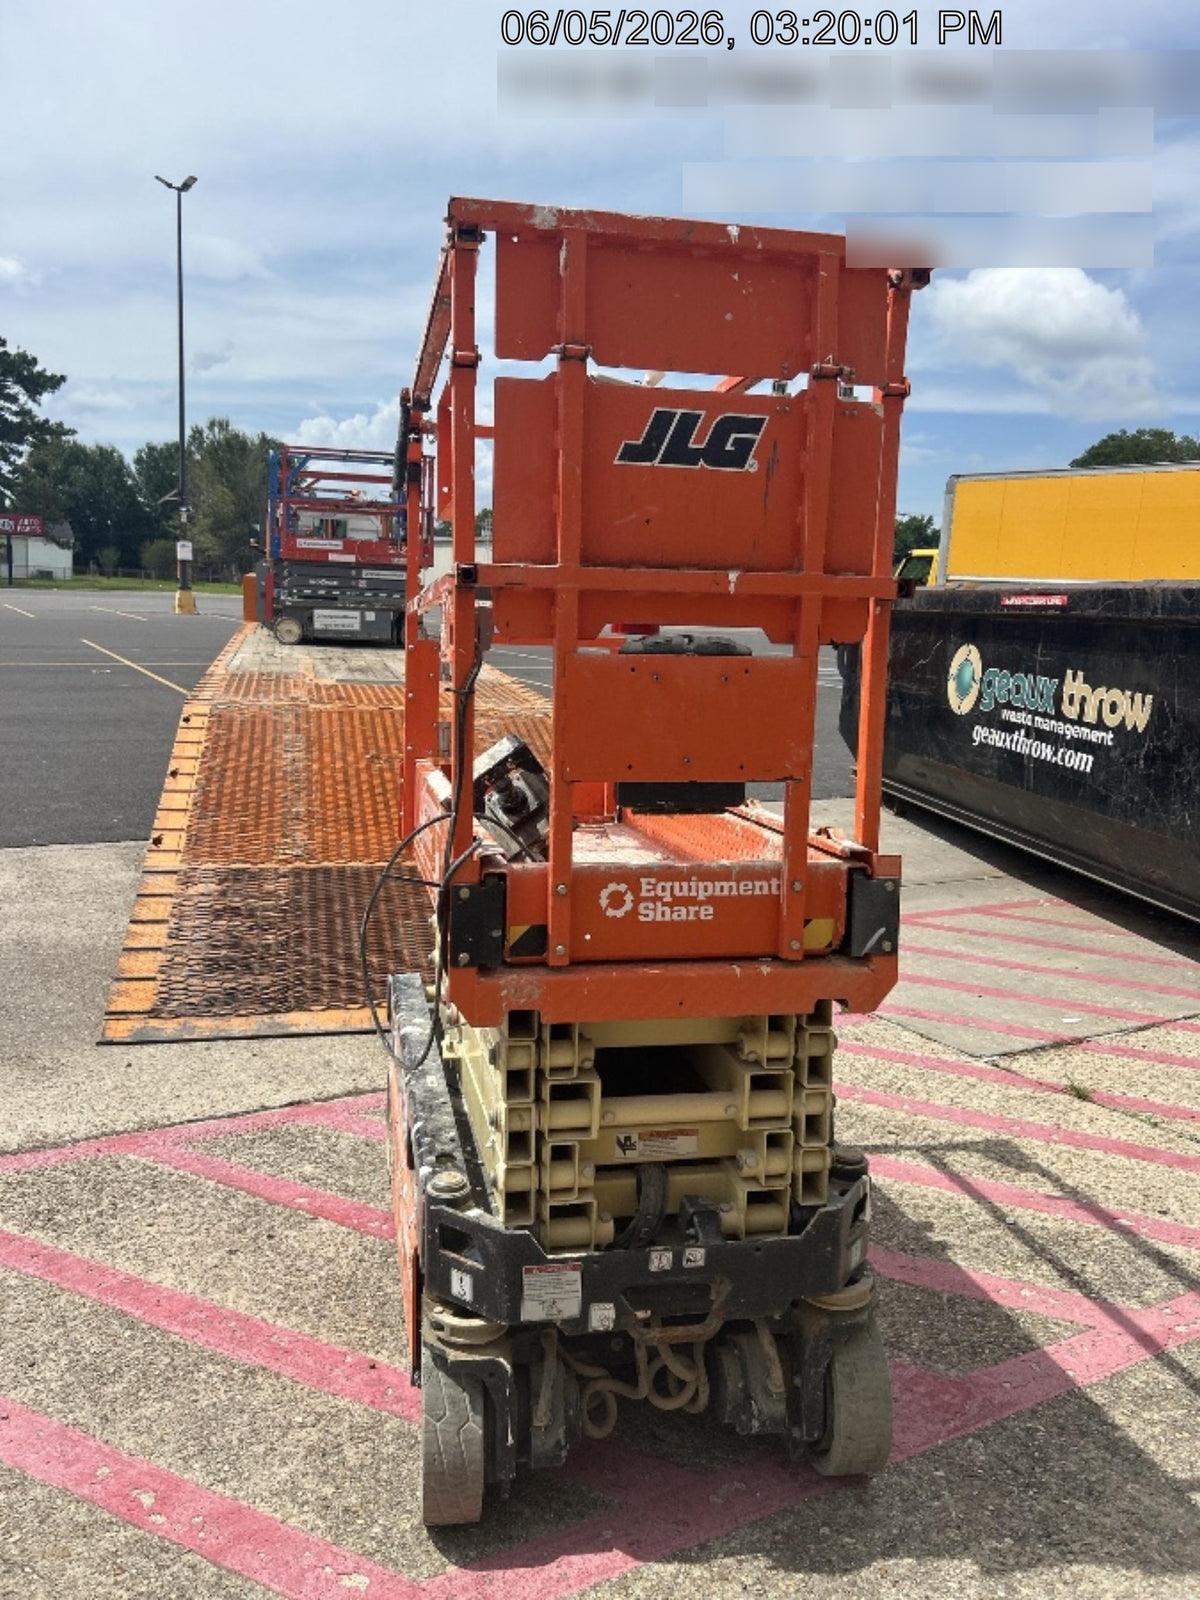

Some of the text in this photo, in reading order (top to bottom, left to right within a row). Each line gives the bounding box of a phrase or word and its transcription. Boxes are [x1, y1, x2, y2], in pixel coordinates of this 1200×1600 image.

[613, 407, 769, 472] JLG
[979, 667, 1153, 734] geaux throw
[972, 724, 1094, 773] geauxthrow.com
[1001, 708, 1114, 746] waste management
[639, 876, 781, 901] Equipment
[637, 901, 714, 922] Share
